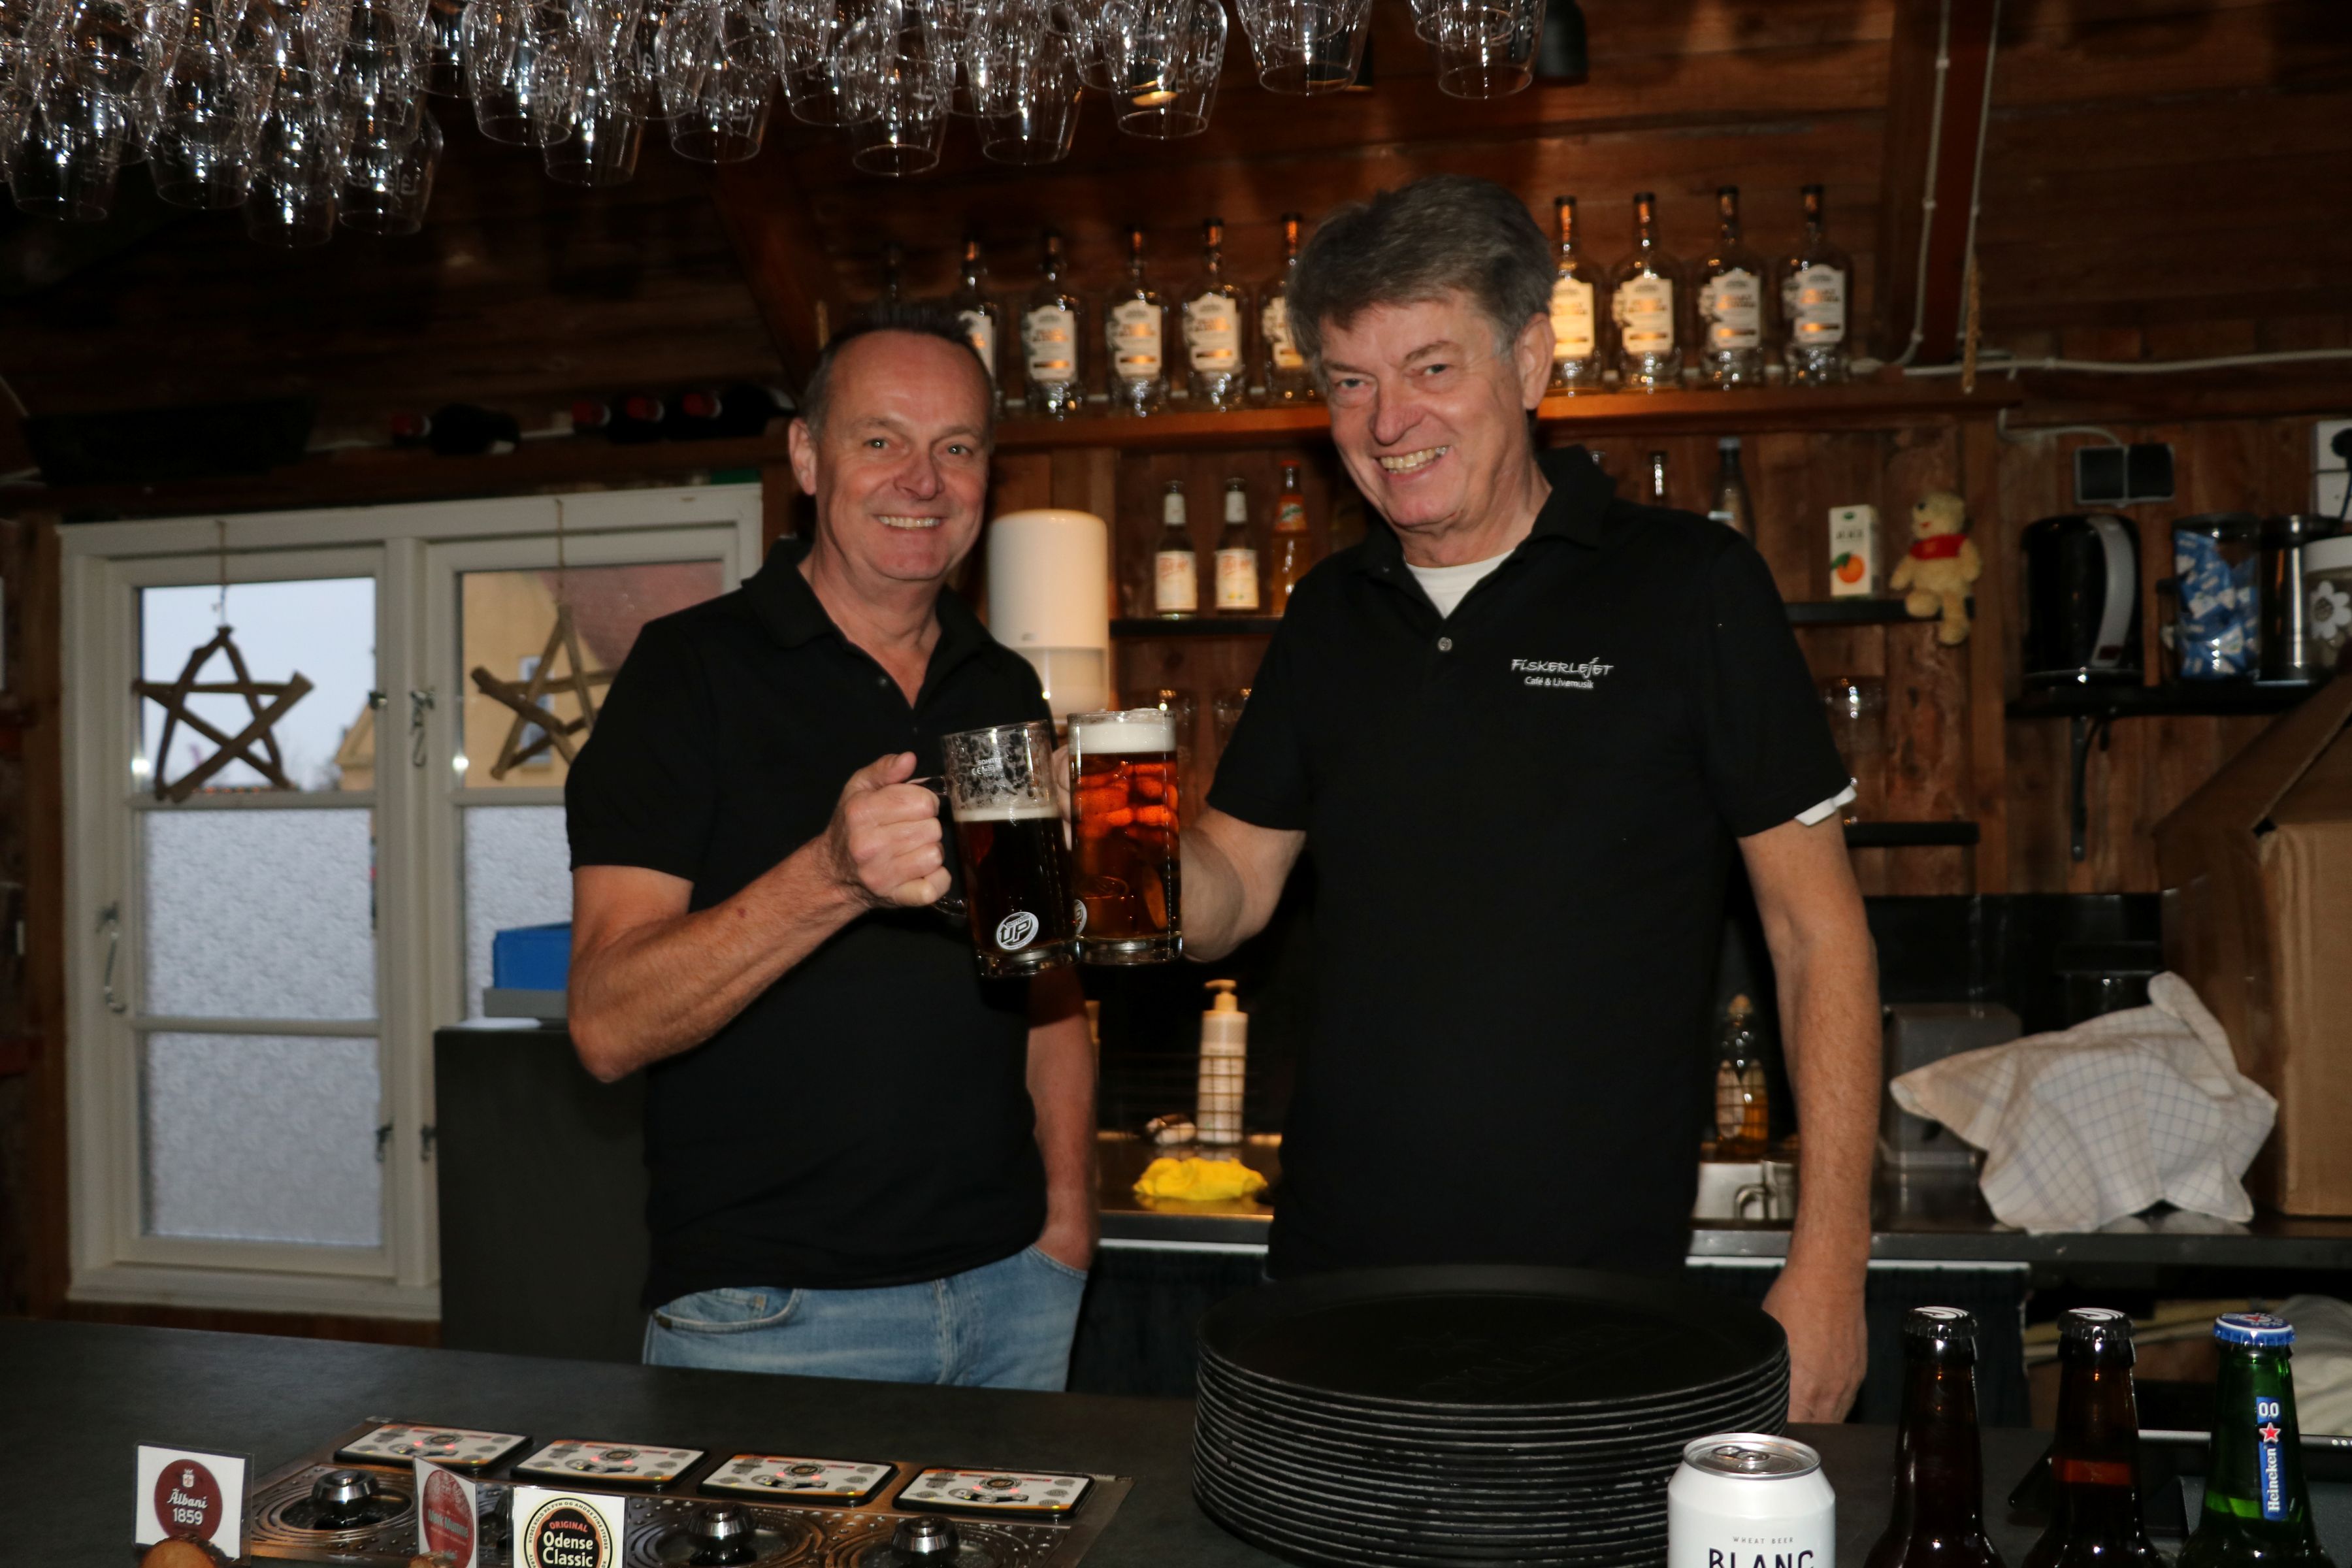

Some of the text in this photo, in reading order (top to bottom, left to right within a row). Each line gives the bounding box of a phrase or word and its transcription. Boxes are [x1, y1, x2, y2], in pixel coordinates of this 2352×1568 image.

[1524, 676, 1594, 689] Café & Livemusik
[1001, 919, 1030, 942] UP
[2266, 1448, 2281, 1512] Heineken
[172, 1508, 203, 1526] 1859
[534, 1513, 544, 1526] KOLD
[575, 1503, 593, 1516] ANDRE
[593, 1516, 602, 1528] FINE
[549, 1521, 587, 1533] ORIGINAL
[543, 1531, 593, 1550] Odense
[542, 1546, 593, 1567] Classic
